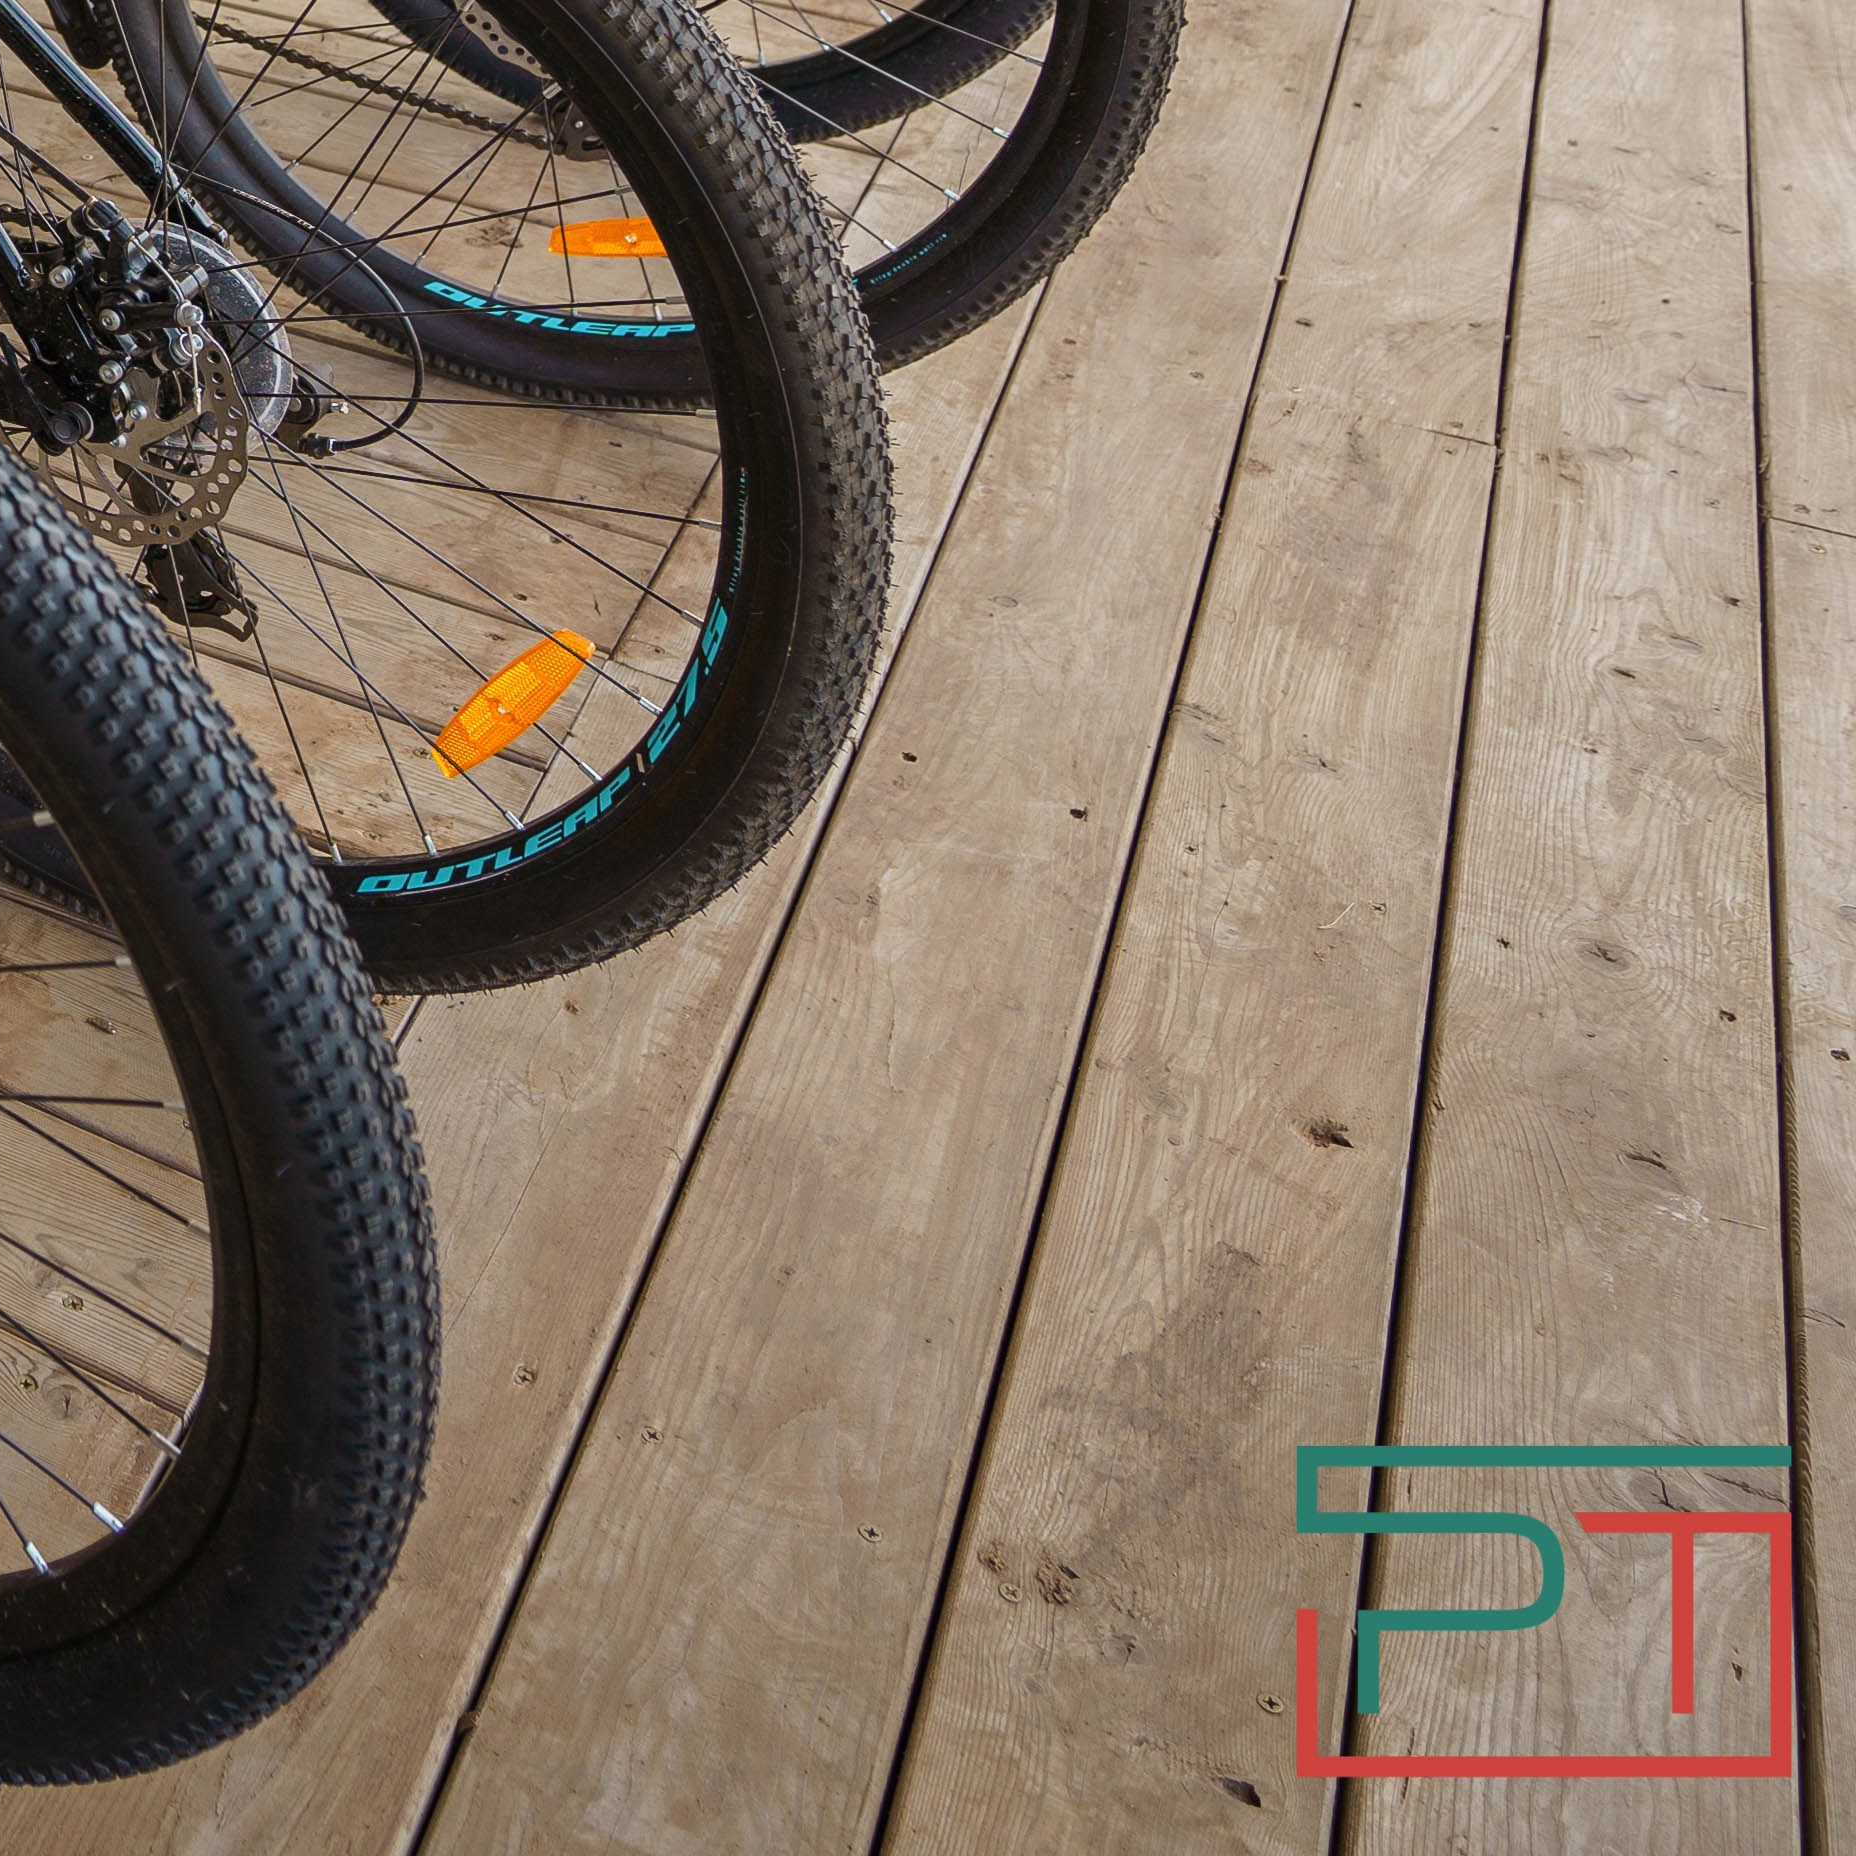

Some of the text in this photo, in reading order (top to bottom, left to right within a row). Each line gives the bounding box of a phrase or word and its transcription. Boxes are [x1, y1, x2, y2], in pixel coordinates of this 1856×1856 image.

[424, 281, 697, 337] OUTLEAP
[357, 597, 728, 893] OUTLEAP 27.5
